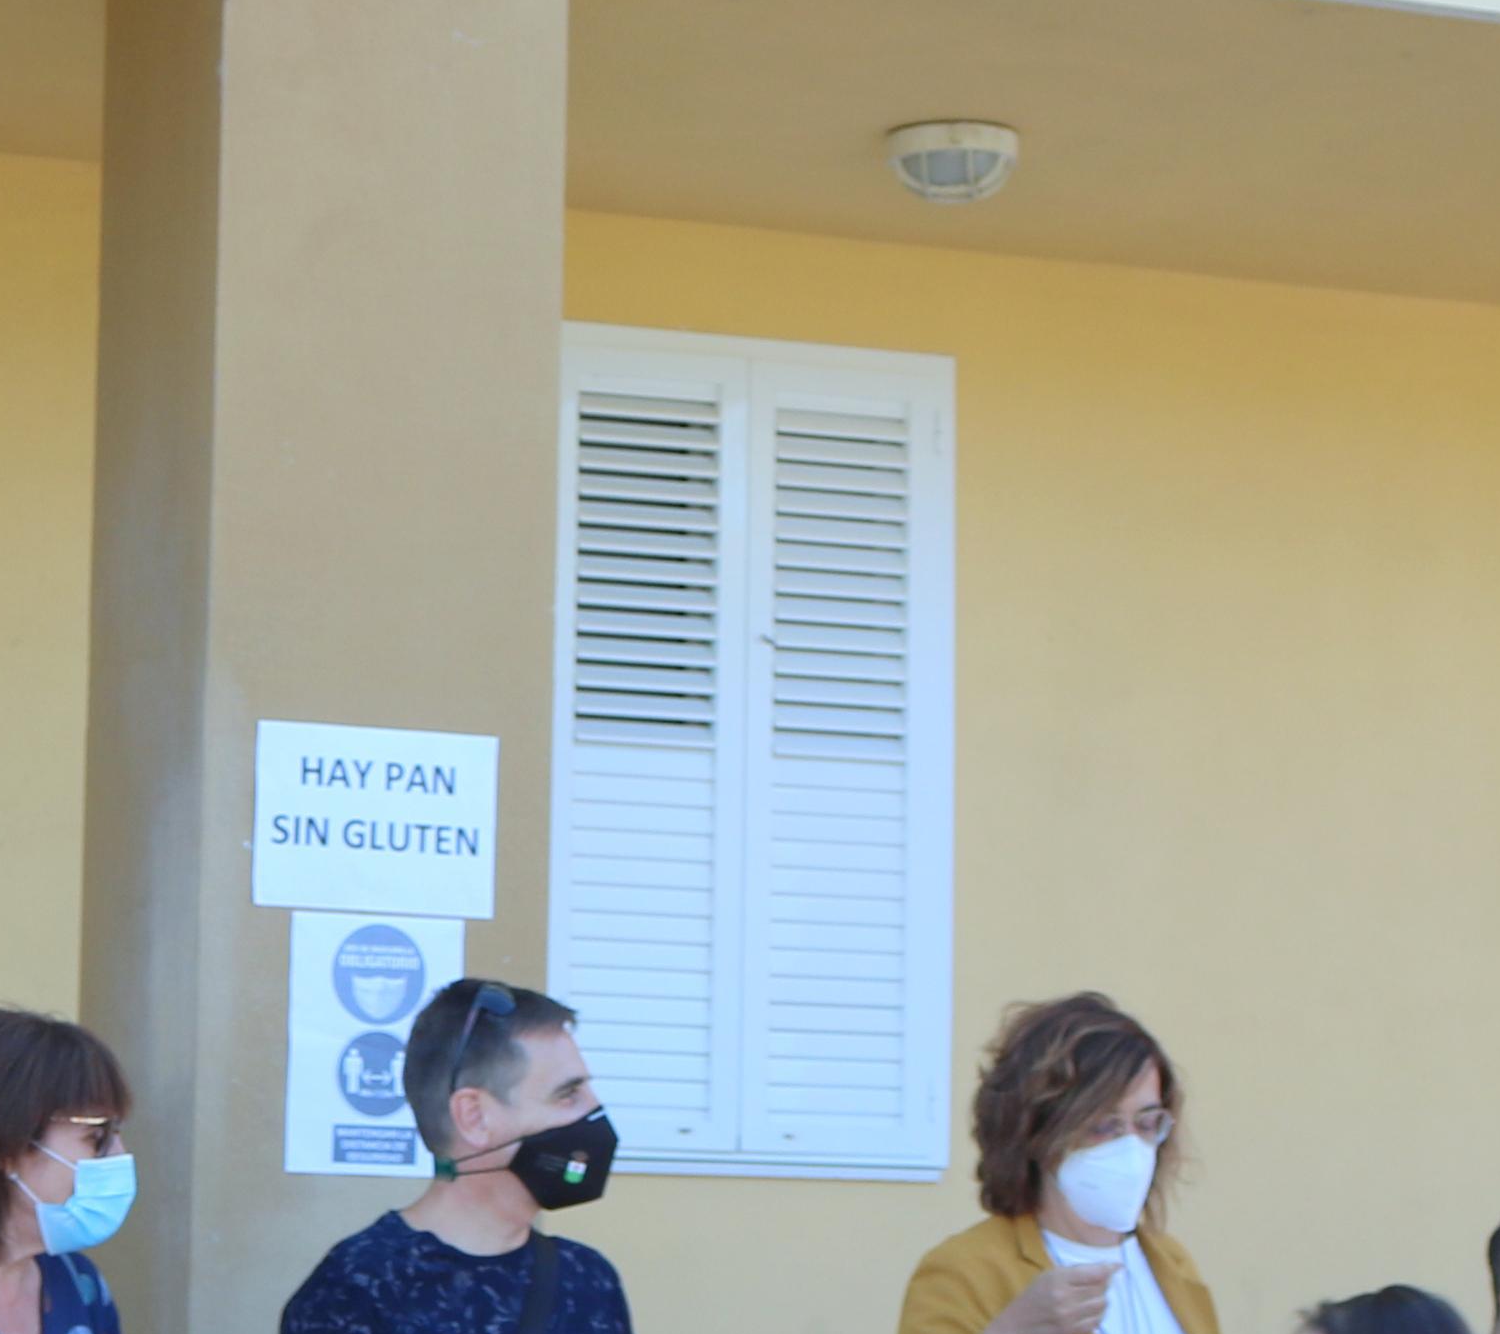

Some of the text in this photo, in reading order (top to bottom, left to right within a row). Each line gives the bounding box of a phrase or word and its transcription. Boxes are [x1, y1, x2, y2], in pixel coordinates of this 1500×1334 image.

[300, 755, 457, 796] HAY PAN
[271, 814, 480, 857] SIN GLUTEN
